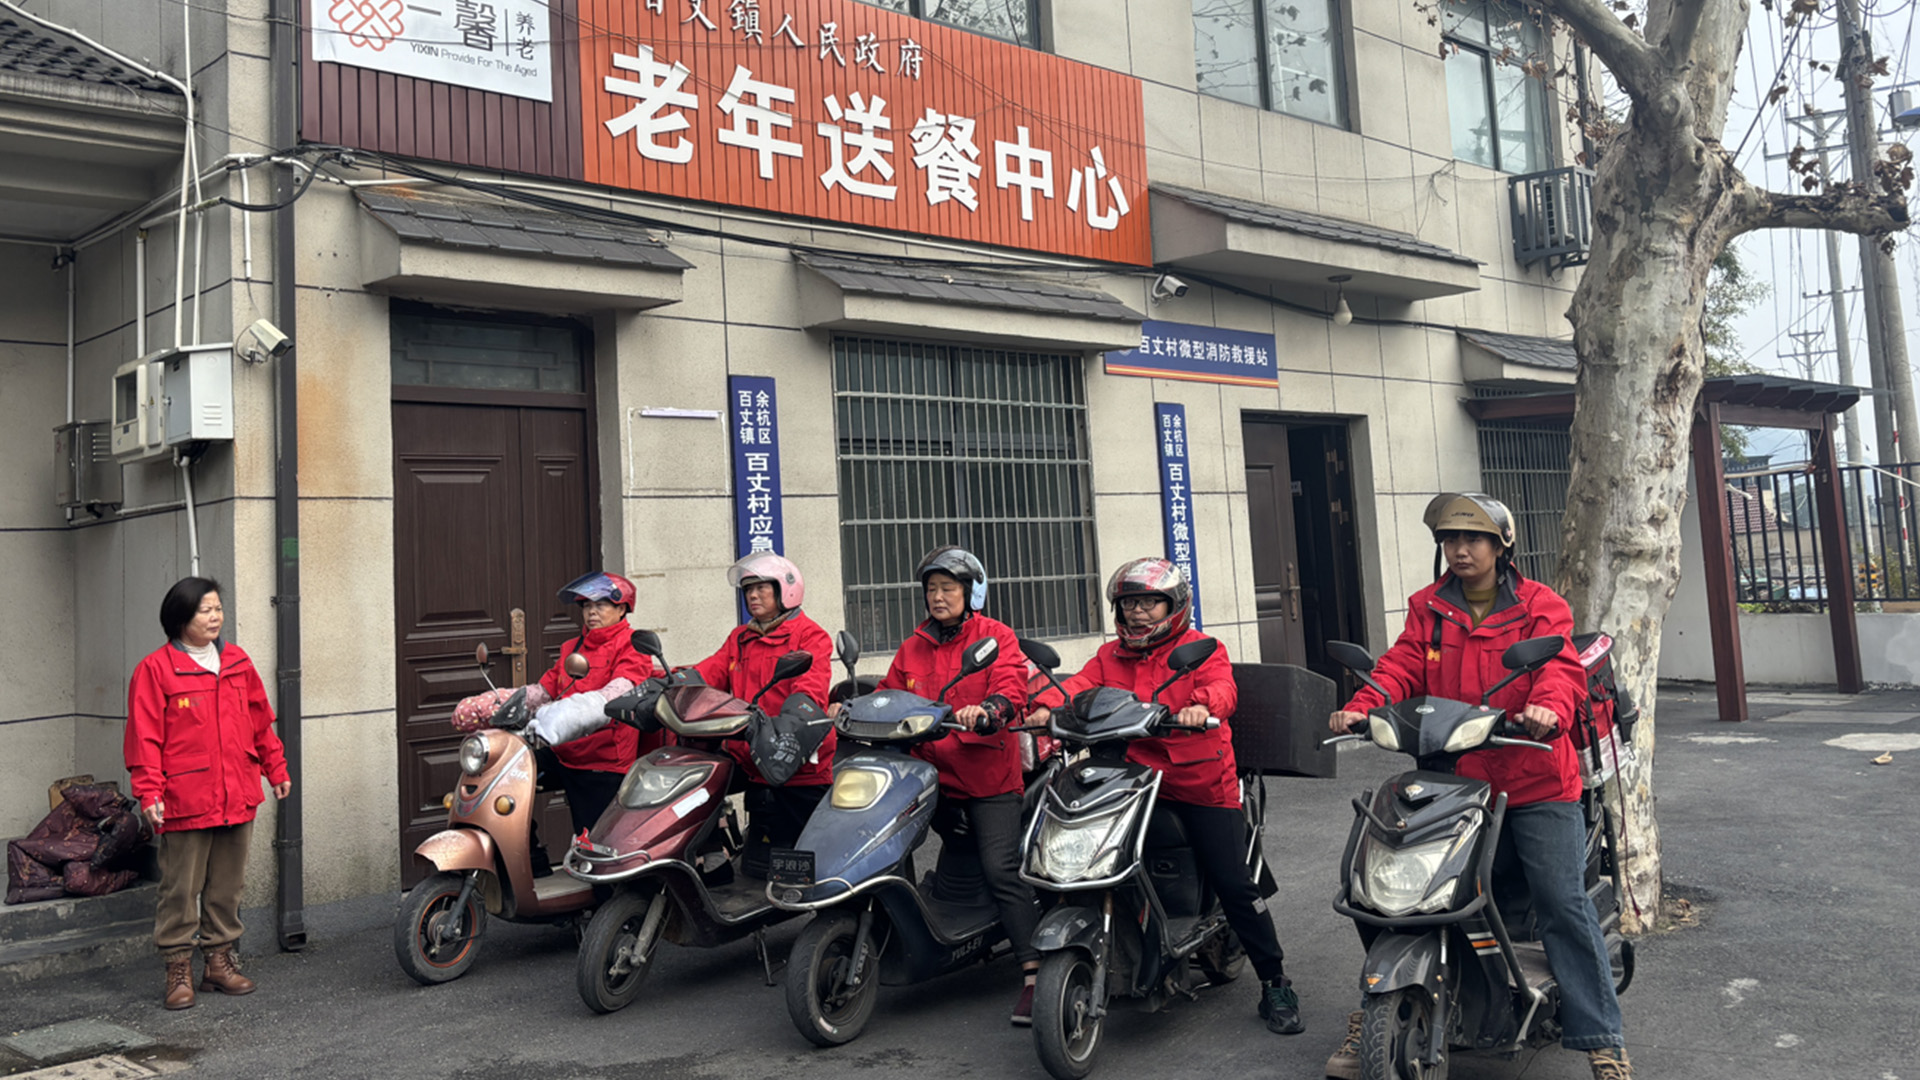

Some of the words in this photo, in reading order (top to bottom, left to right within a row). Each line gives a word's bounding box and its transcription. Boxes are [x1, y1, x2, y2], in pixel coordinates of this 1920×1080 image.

[515, 11, 536, 61] 养老
[410, 42, 439, 57] YIXIN
[441, 49, 475, 65] Provide
[477, 58, 493, 68] For
[495, 59, 512, 73] The
[514, 64, 538, 77] Aged
[603, 43, 1130, 231] 老年送餐中心
[1138, 335, 1268, 367] 百丈村微型消防救援站
[738, 390, 755, 445] 百丈镇
[756, 390, 772, 444] 余杭区
[1162, 414, 1174, 457] 百丈镇
[1173, 414, 1185, 457] 余杭区
